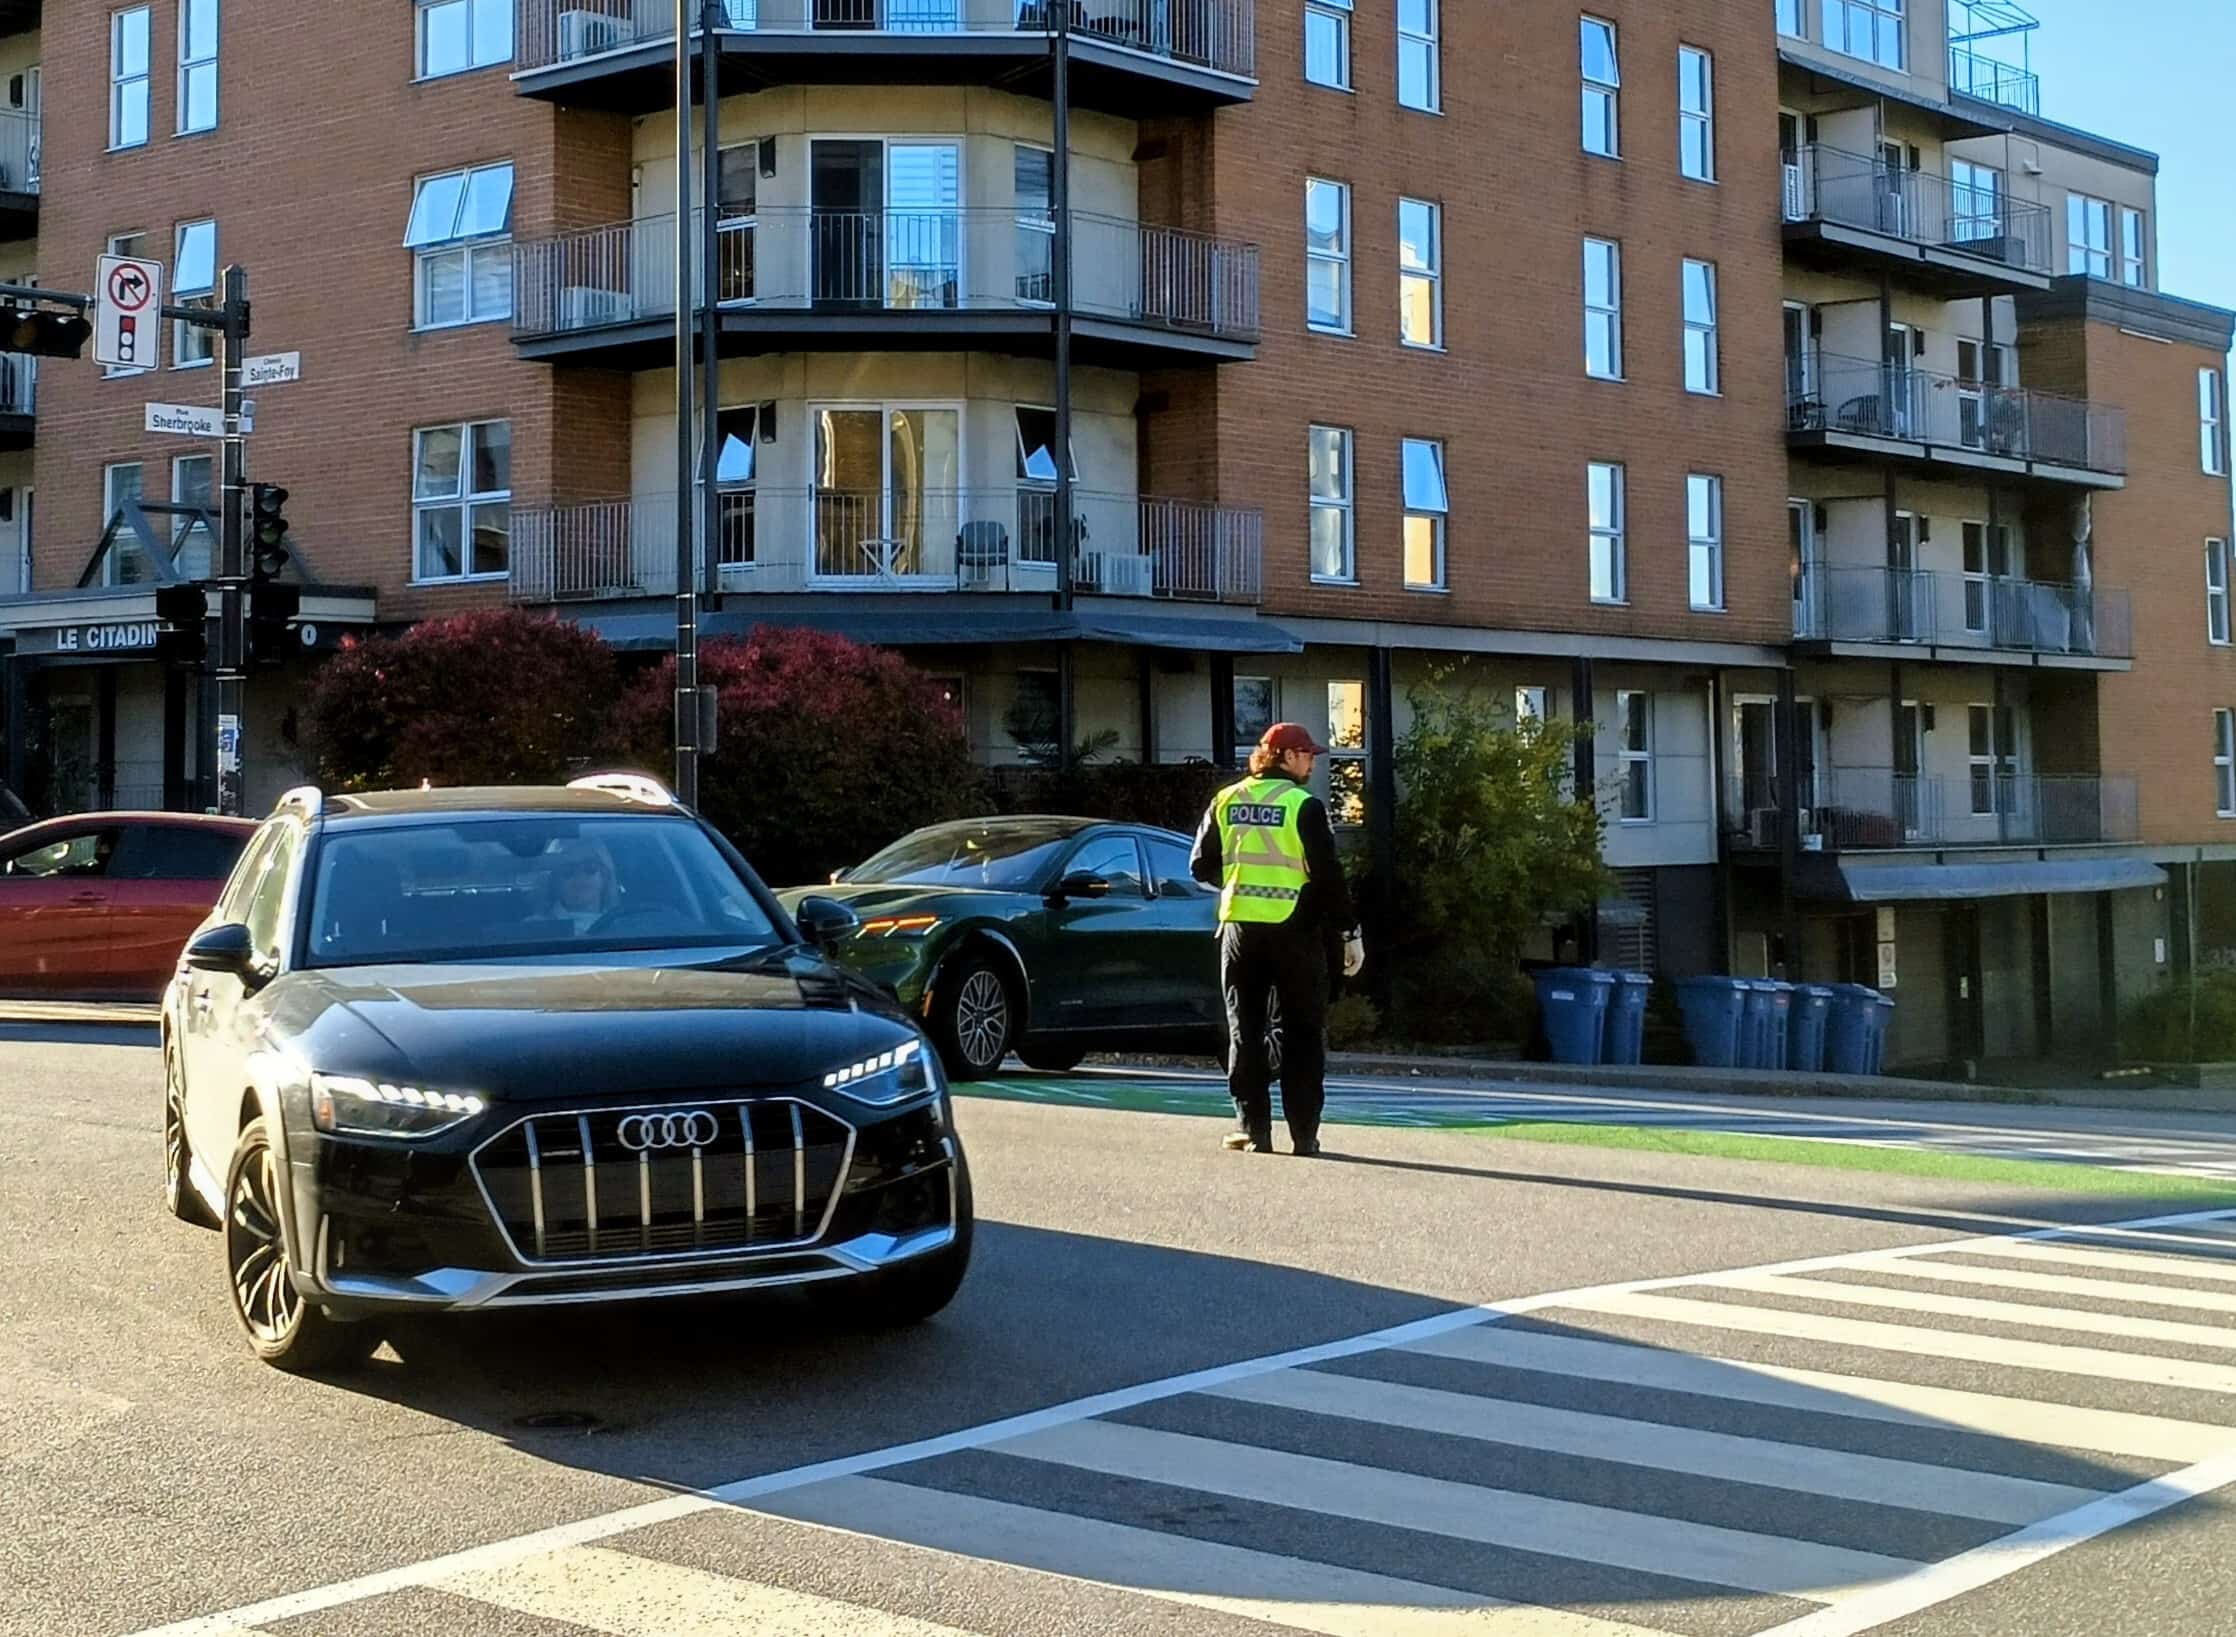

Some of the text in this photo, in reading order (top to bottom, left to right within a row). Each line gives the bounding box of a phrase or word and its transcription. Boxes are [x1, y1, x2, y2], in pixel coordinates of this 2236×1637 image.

[152, 415, 212, 432] Sherbrooke
[57, 628, 78, 649] LE
[86, 623, 160, 648] CITADIN
[1230, 806, 1281, 824] POLICE
